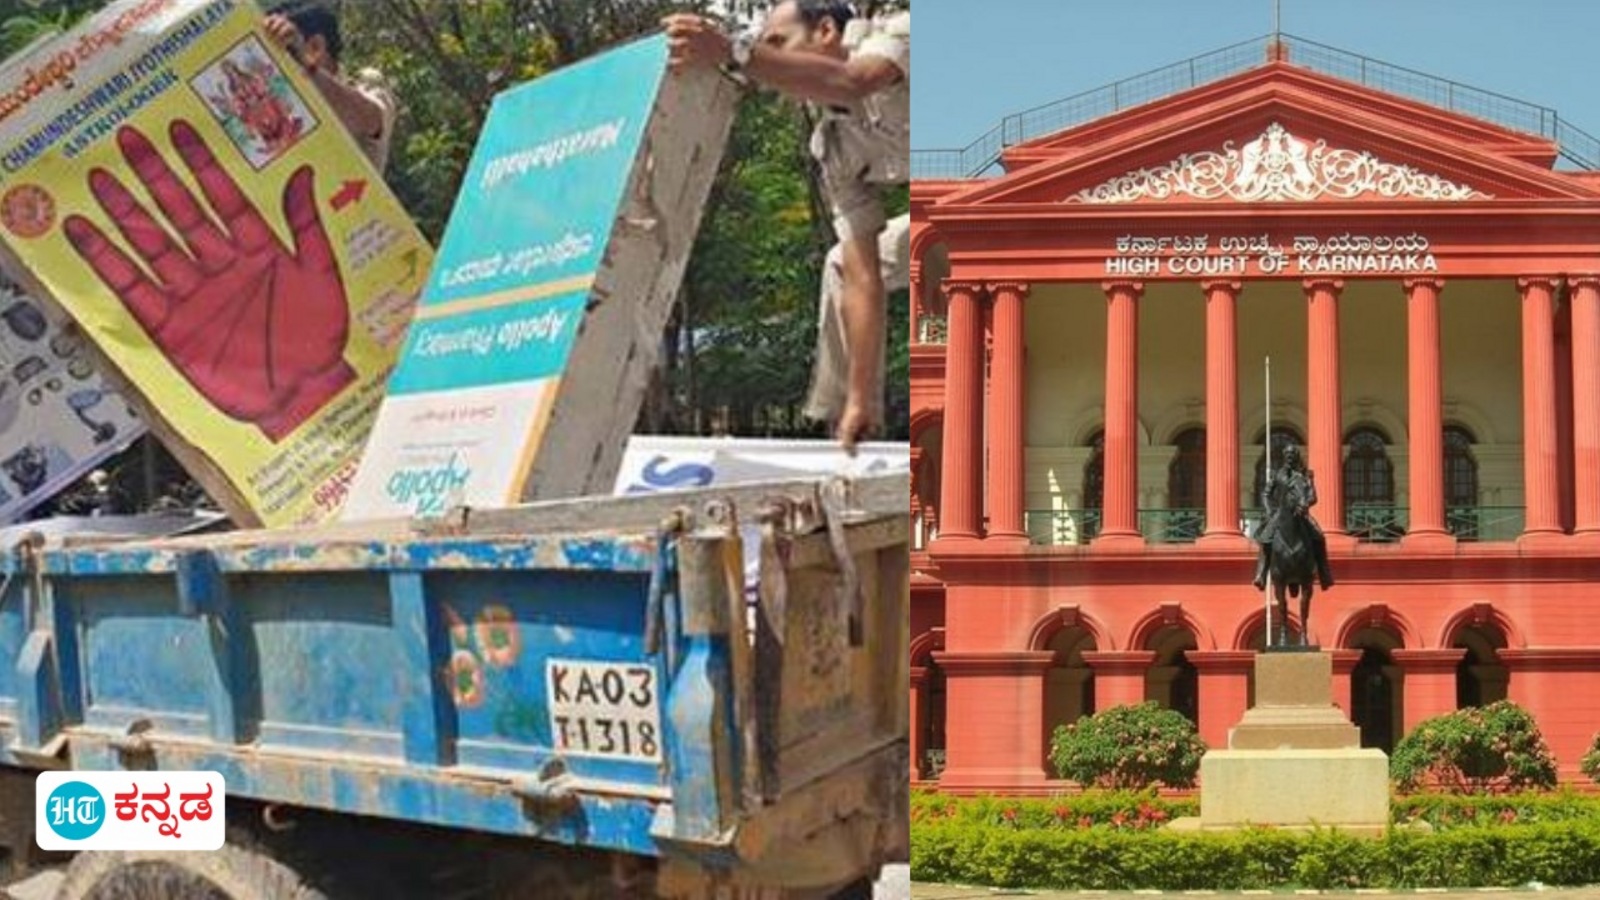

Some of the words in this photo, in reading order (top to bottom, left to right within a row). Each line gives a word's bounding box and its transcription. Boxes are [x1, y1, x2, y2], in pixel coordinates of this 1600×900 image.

[1116, 234, 1210, 253] ಕರ್ನಾಟಕ
[1105, 256, 1160, 274] HIGH
[1168, 255, 1249, 273] COURT
[1258, 255, 1290, 273] OF
[1298, 254, 1438, 272] KARNATAKA
[497, 308, 568, 351] Apollo
[387, 451, 471, 503] Apollo
